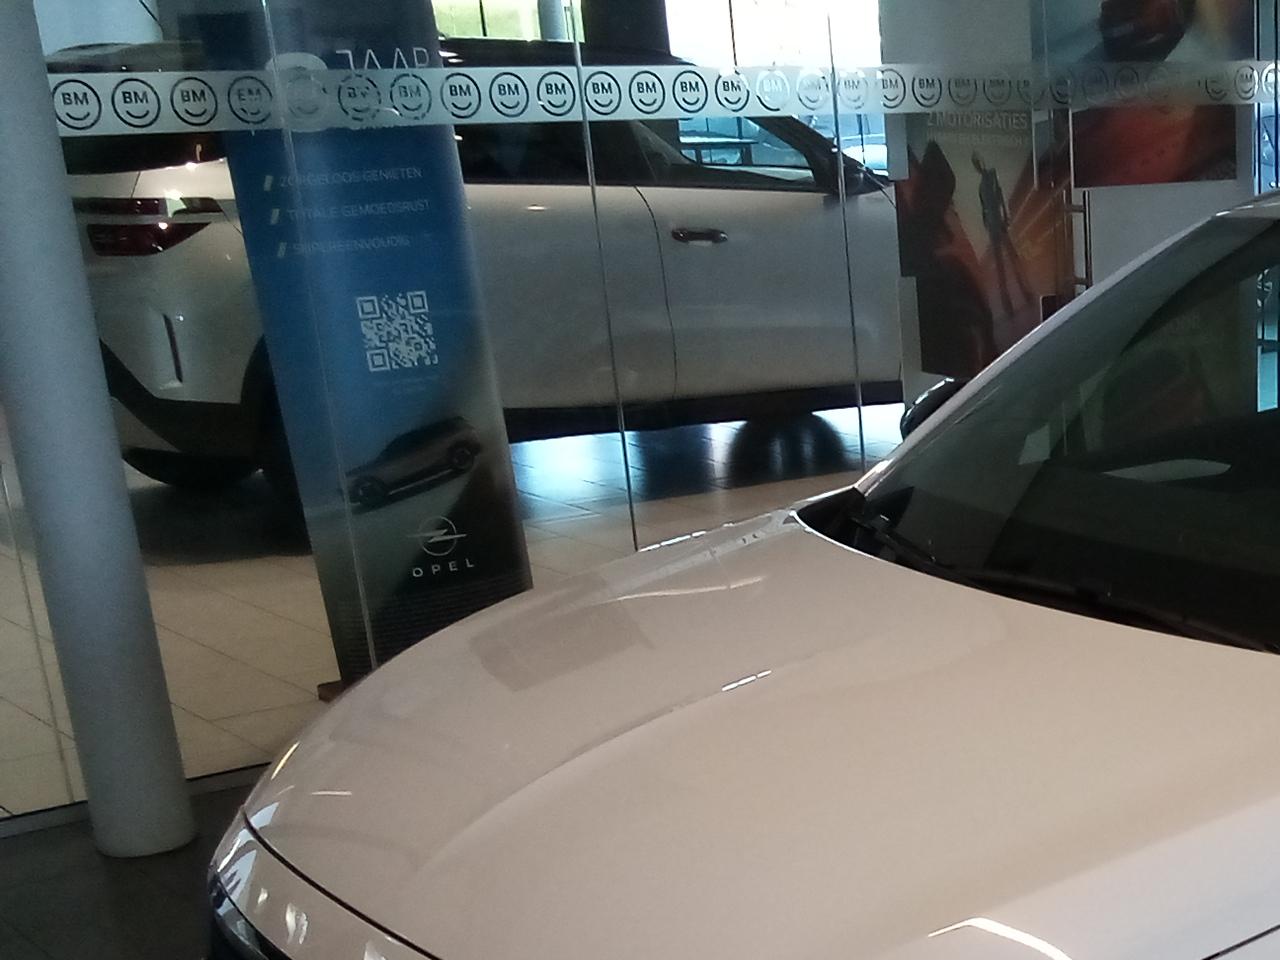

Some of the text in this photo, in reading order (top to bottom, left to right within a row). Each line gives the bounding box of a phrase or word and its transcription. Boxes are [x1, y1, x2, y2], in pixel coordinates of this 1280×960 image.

[62, 92, 89, 106] BM
[122, 91, 149, 104] BM
[180, 89, 206, 103] BM
[398, 85, 421, 98] BM
[449, 84, 472, 97] BM
[498, 83, 520, 96] BM
[545, 82, 567, 95] BM
[592, 82, 613, 94] BM
[636, 81, 657, 93] BM
[680, 80, 700, 93] BM
[723, 80, 742, 92] BM
[882, 78, 899, 90] BM
[919, 78, 935, 89] BM
[362, 167, 424, 183] GENIETEN
[342, 200, 431, 217] GEMOEDSRUST
[412, 558, 475, 577] OPEL
